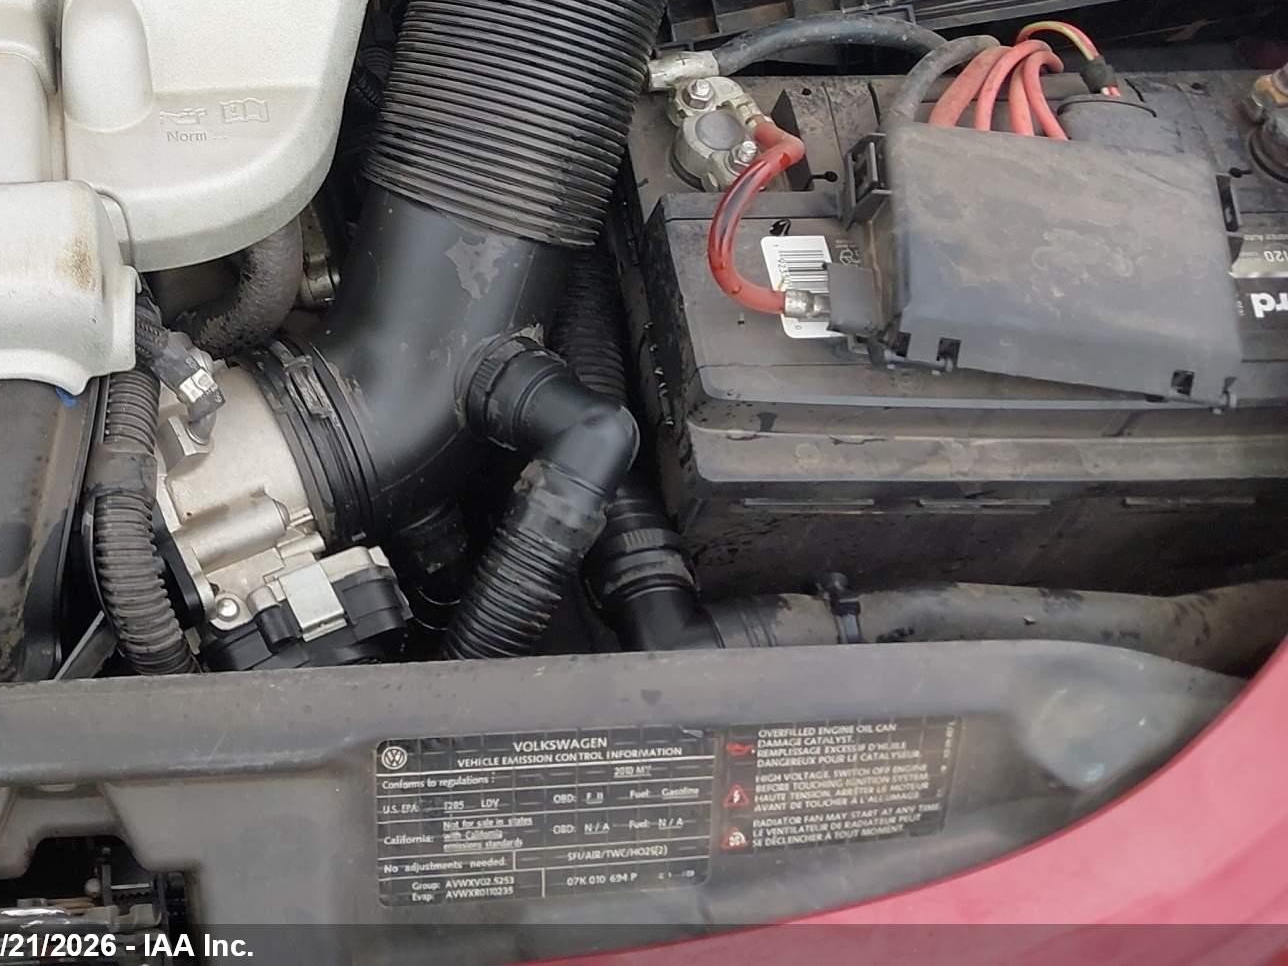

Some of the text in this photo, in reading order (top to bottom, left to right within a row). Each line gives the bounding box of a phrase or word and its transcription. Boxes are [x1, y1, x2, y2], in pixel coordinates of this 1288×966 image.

[167, 131, 208, 142] Norm
[758, 723, 897, 738] OVERFILLED ENGINE OIL CAN
[513, 738, 608, 753] VOLKSWAGEN
[758, 738, 802, 748] DAMAGE
[457, 747, 683, 768] VEHICLE EMISSION CONTROL INFORMATION
[382, 779, 425, 790] Conforms
[427, 778, 437, 788] to
[661, 786, 700, 797] Gasoline
[481, 798, 500, 809] LDV
[753, 816, 803, 828] RADIATOR
[804, 814, 824, 824] FAN
[825, 812, 848, 822] MAY
[851, 809, 878, 820] START
[384, 834, 435, 845] California:
[384, 864, 399, 874] No
[405, 861, 464, 873] adjustments
